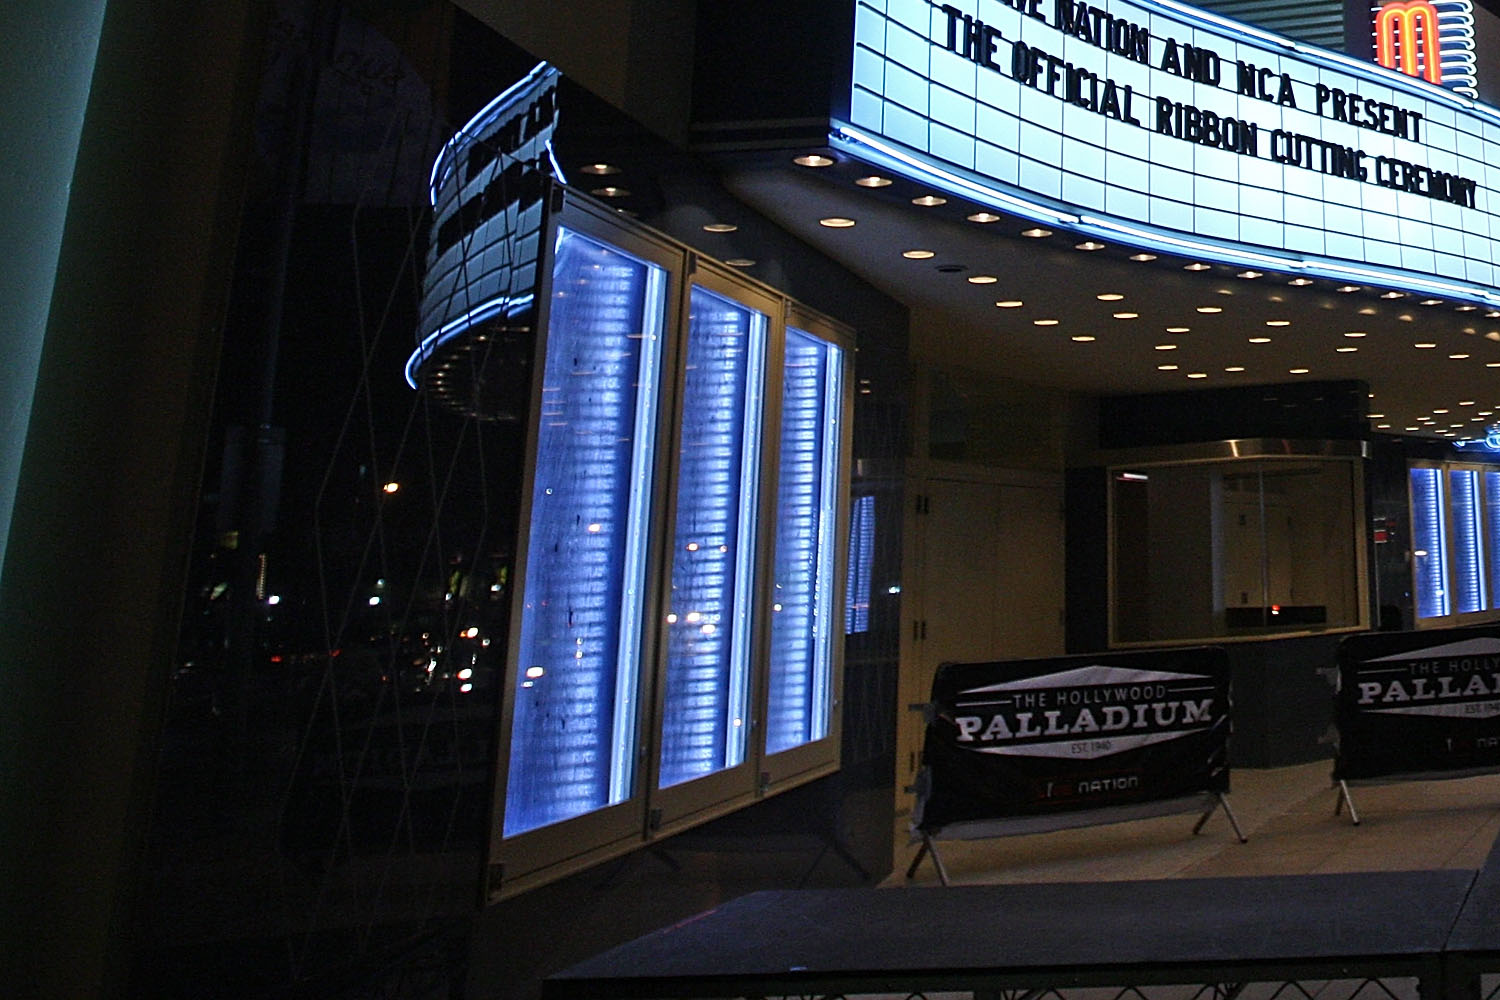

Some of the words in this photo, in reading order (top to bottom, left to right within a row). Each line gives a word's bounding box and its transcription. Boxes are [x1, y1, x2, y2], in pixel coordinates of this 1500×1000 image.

[941, 4, 1002, 72] THE
[1011, 40, 1141, 128] OFFICIAL
[1156, 95, 1258, 157] RIBBON
[1271, 128, 1368, 183] CUTTING
[1375, 155, 1477, 210] CEREMONY
[1161, 37, 1221, 87] AND
[1236, 59, 1297, 109] NCA
[1315, 83, 1423, 144] PRESENT
[1409, 661, 1440, 675] THE
[955, 697, 1215, 743] PALLADIUM
[1012, 693, 1047, 709] THE
[1056, 685, 1167, 705] HOLLYWOOD
